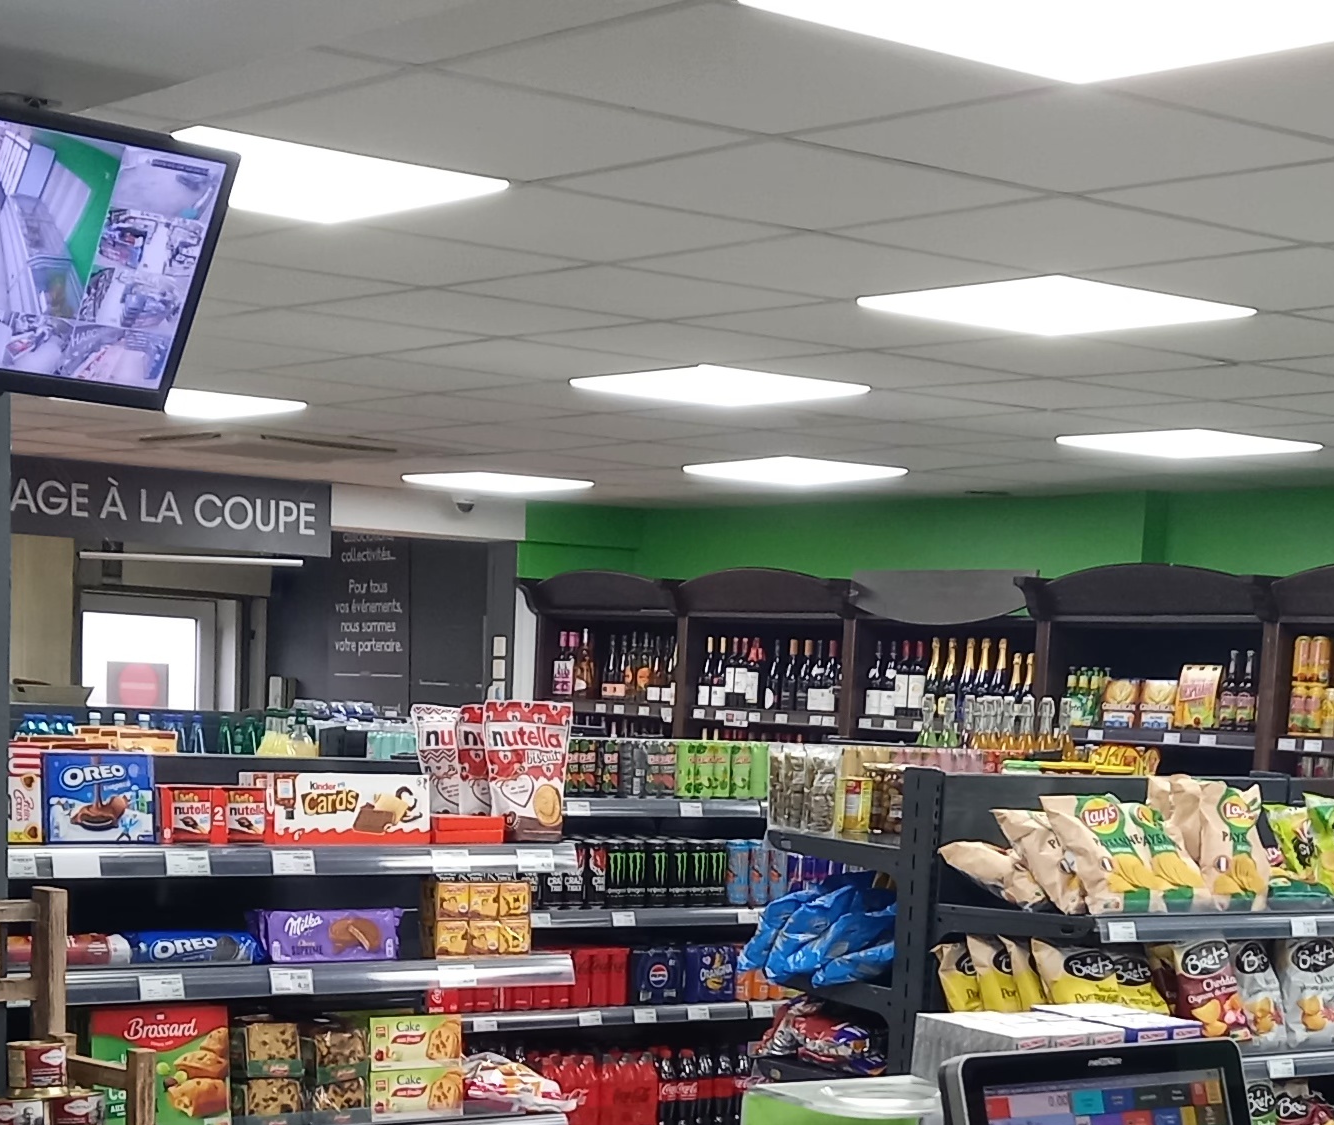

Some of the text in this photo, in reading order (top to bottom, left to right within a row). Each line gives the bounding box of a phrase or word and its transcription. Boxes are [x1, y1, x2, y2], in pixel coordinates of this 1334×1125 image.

[99, 477, 128, 522] À
[140, 488, 183, 527] LA
[194, 493, 317, 537] COUPE
[348, 578, 388, 594] Pour tous
[335, 602, 349, 613] vos
[340, 621, 396, 632] nous sommes
[335, 638, 403, 657] votre partenaire.
[491, 725, 563, 749] nutella
[62, 763, 125, 788] OREO
[303, 790, 357, 815] Cards
[213, 805, 224, 822] 2
[1083, 804, 1117, 827] Lay's
[285, 913, 324, 936] Milka
[154, 936, 217, 958] OREO
[124, 1017, 198, 1042] Brossard
[395, 1021, 421, 1032] Cake
[396, 1074, 422, 1085] Cake
[108, 1088, 127, 1101] Ca
